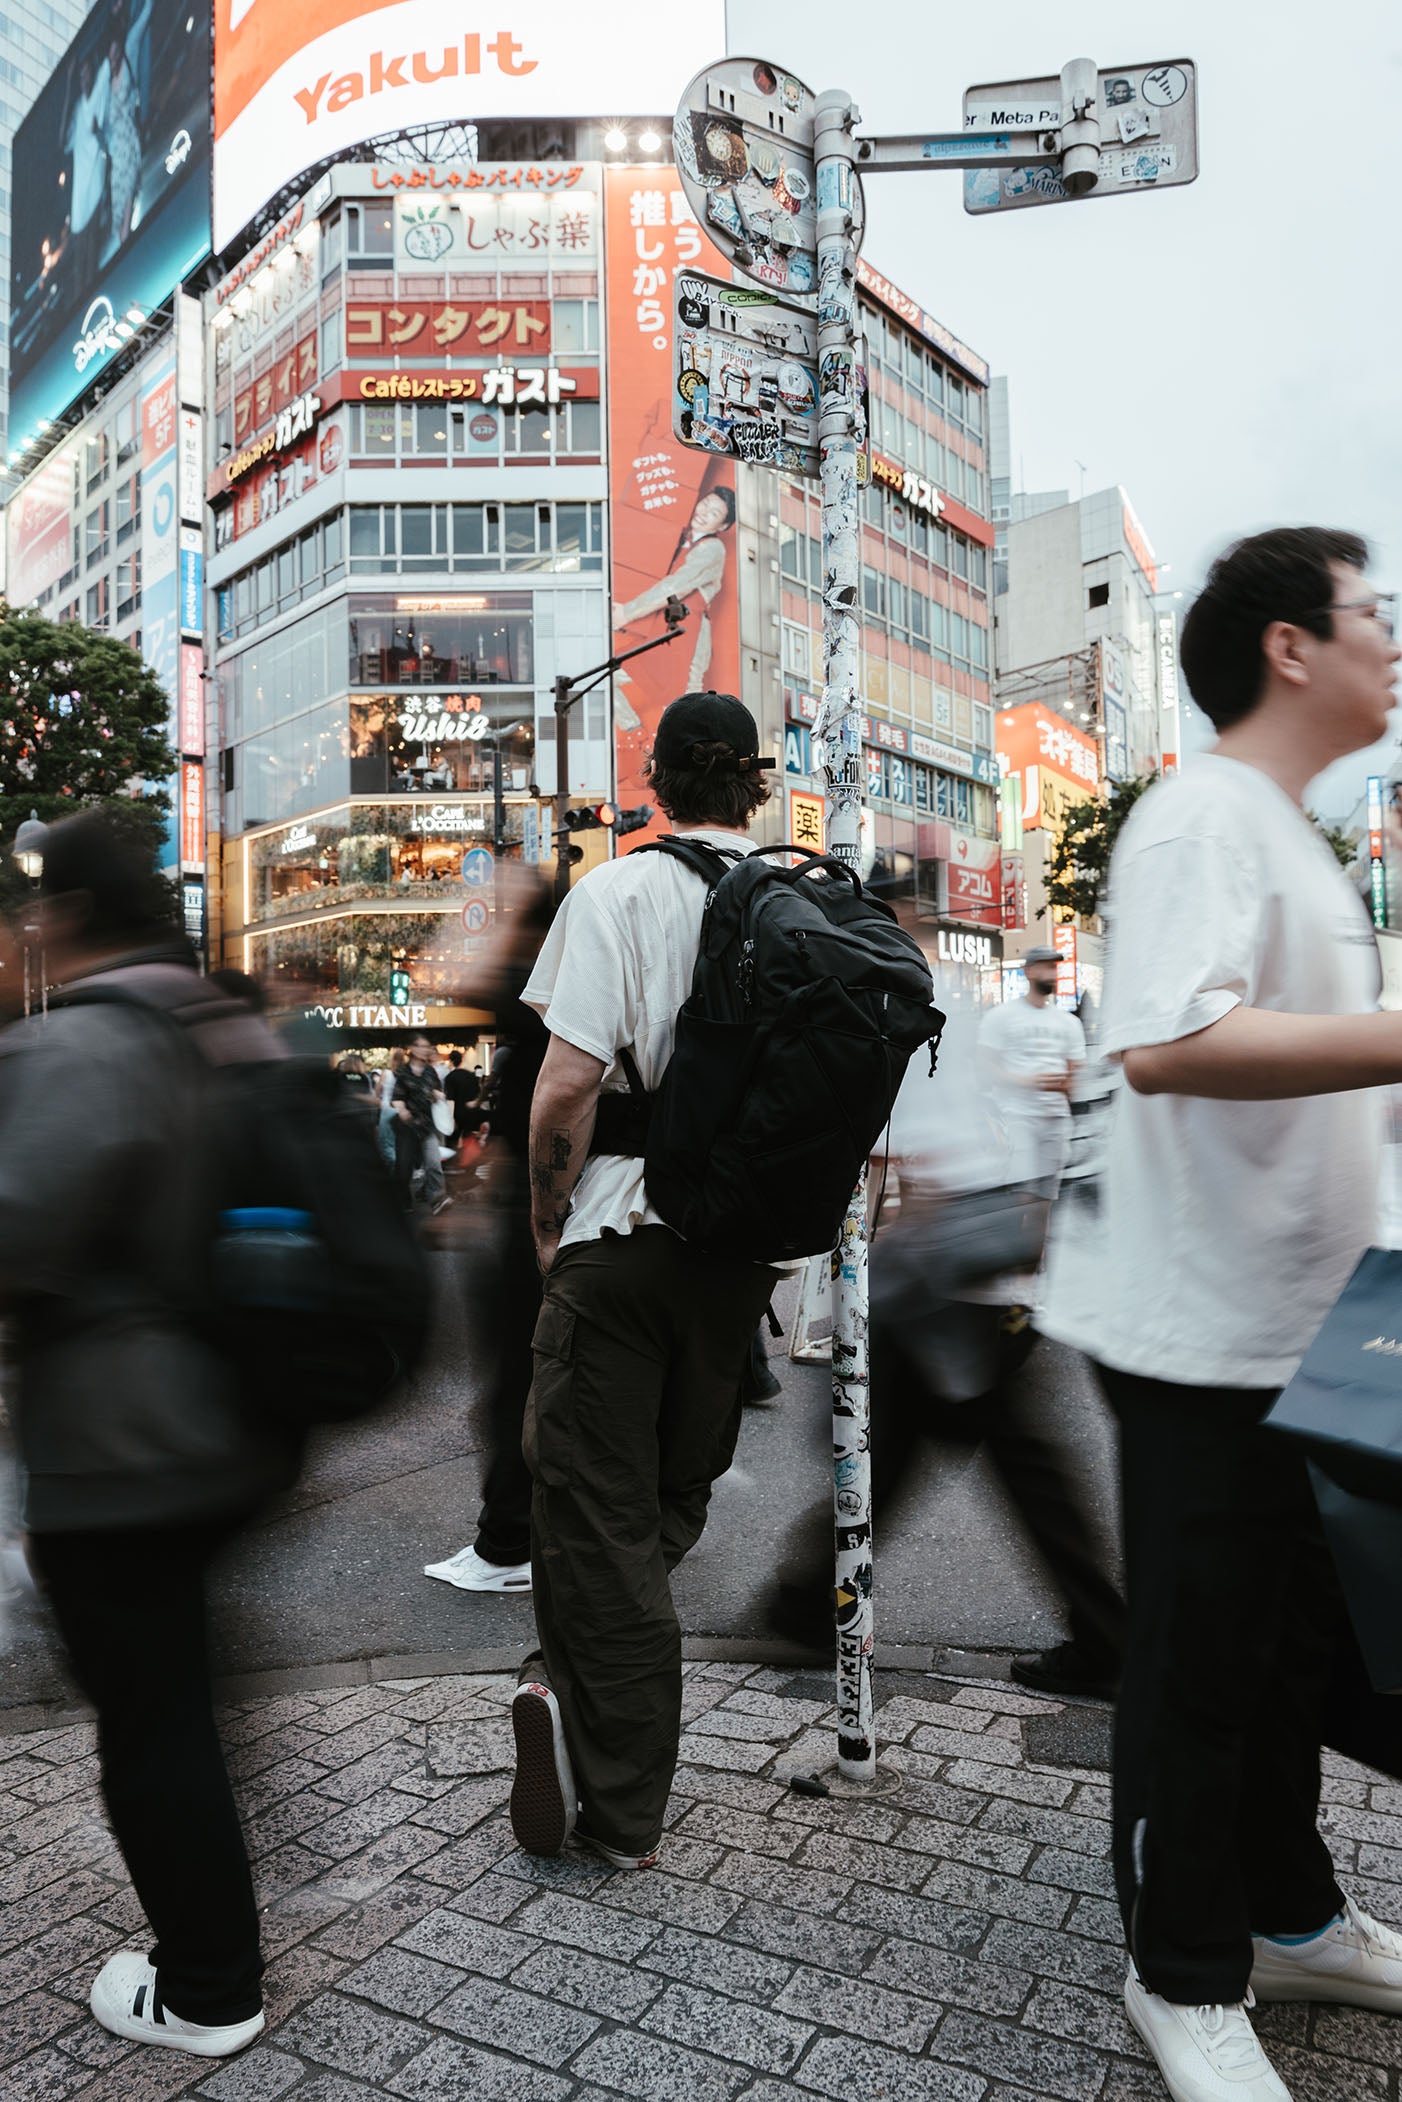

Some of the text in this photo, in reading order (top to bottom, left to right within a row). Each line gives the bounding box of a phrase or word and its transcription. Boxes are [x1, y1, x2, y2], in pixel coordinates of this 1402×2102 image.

[293, 31, 539, 125] Yakult
[991, 112, 1033, 126] Meta
[1039, 110, 1059, 122] Pa
[371, 166, 584, 189] しゃぶしゃぶバイキング
[467, 211, 590, 251] しゃぶ葉
[629, 189, 668, 350] 推しから。
[347, 305, 546, 346] コンタクト
[359, 367, 577, 404] Caféレストラン ガスト
[275, 391, 321, 451] ガスト
[902, 471, 945, 517] ガスト
[1159, 645, 1176, 710] CAMERA
[397, 711, 490, 742] Ushi8
[978, 759, 999, 784] 4F
[796, 803, 819, 843] 薬
[957, 869, 992, 899] アコム
[938, 930, 991, 966] LUSH
